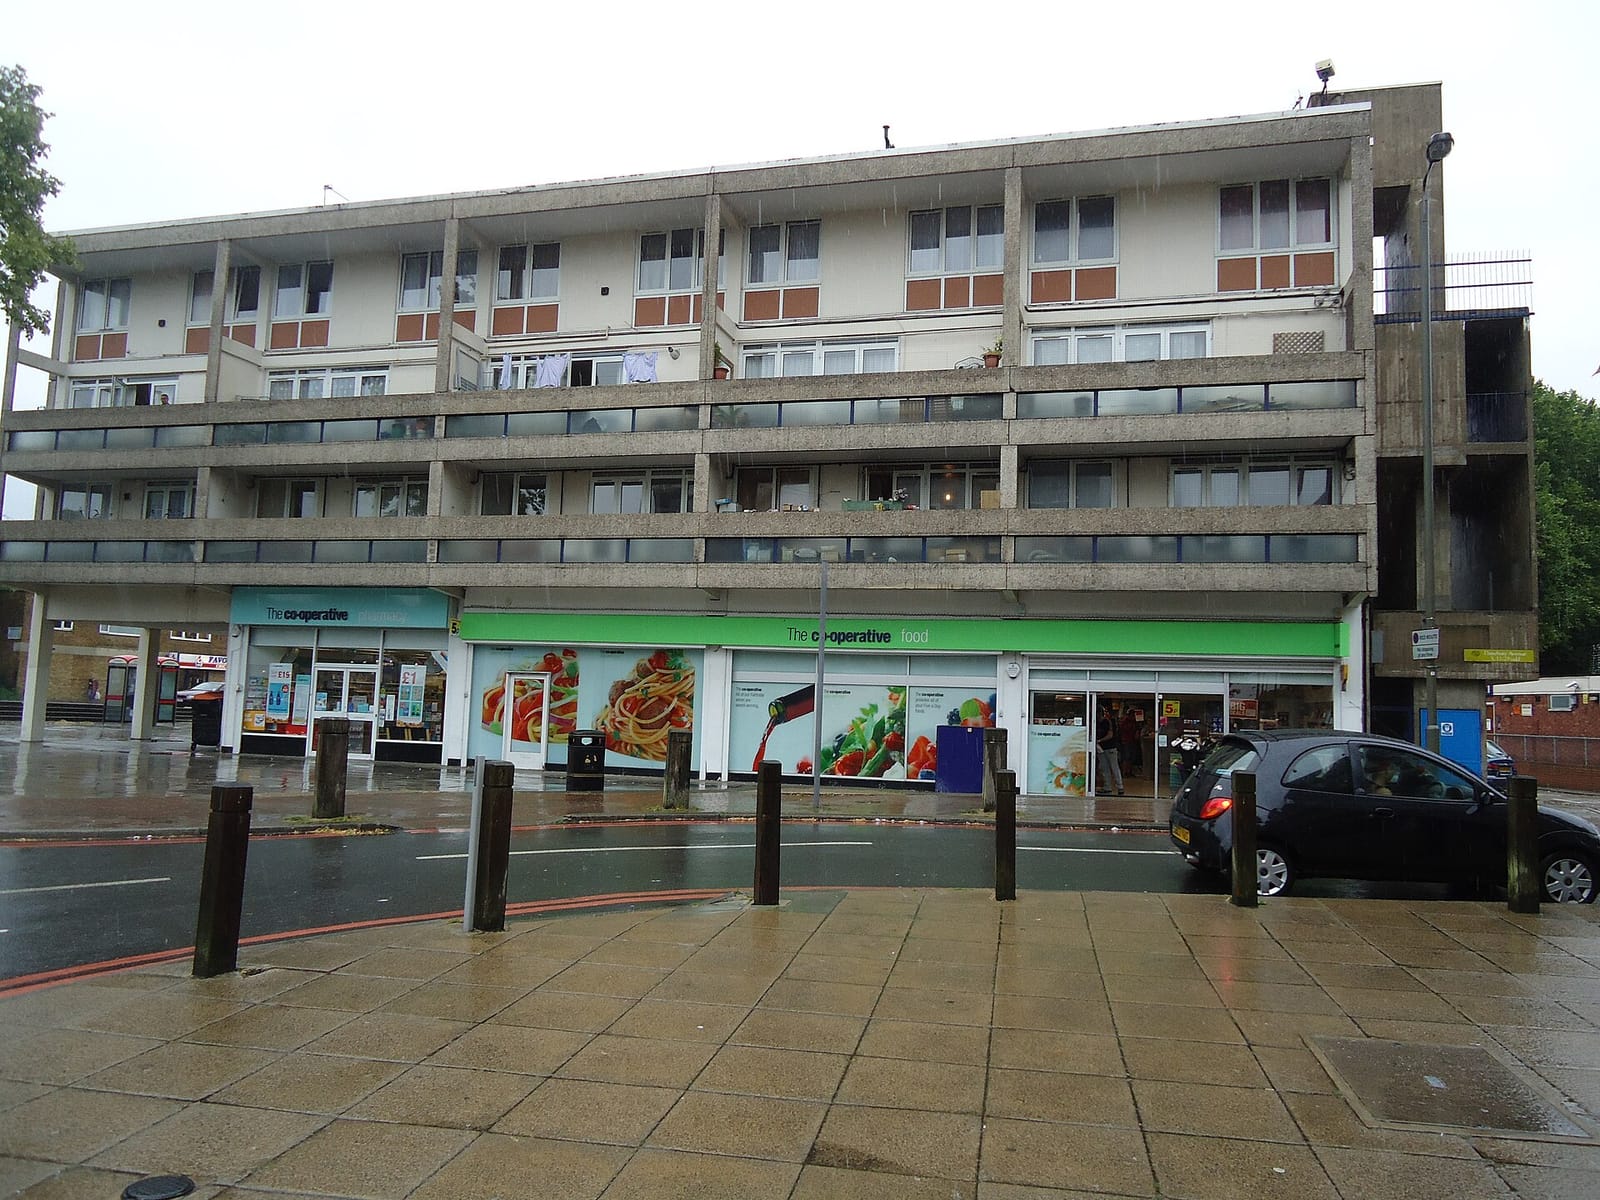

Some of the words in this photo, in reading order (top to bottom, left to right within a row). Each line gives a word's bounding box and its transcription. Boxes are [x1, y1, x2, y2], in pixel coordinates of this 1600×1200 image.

[267, 607, 283, 620] The
[283, 608, 348, 623] co-operative
[787, 627, 808, 642] The
[811, 628, 891, 646] c-operative
[901, 628, 929, 643] food
